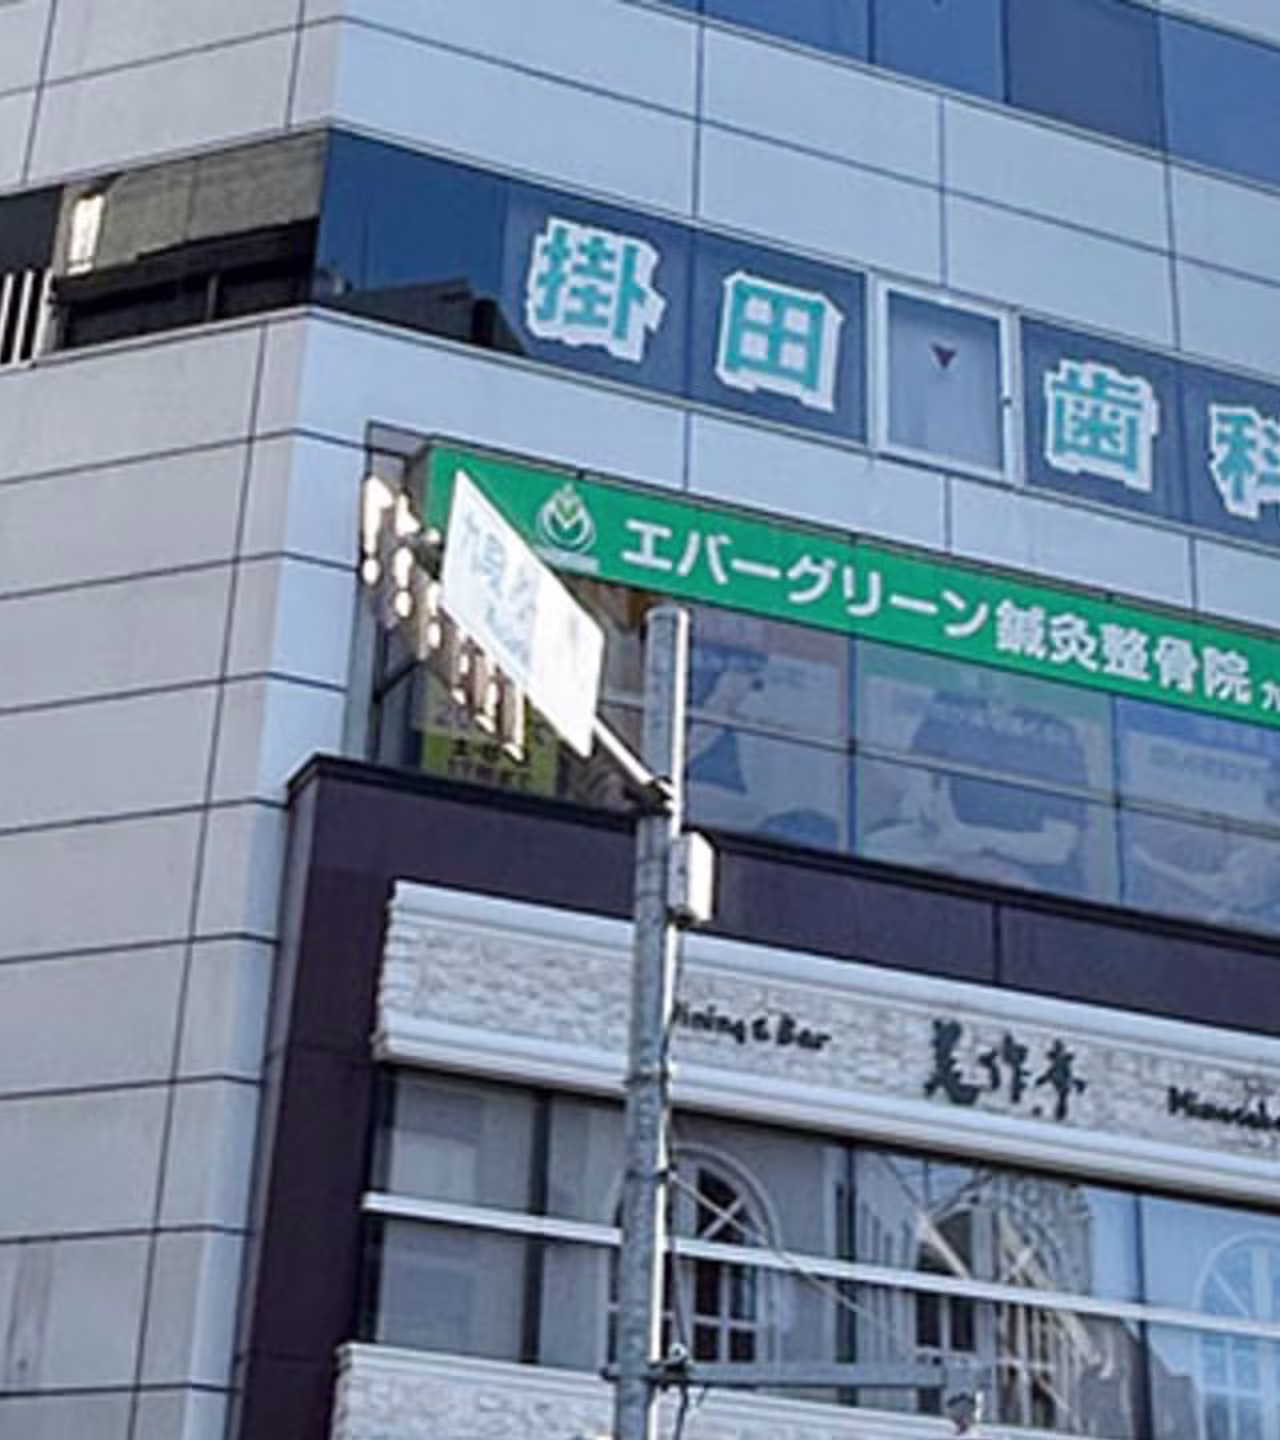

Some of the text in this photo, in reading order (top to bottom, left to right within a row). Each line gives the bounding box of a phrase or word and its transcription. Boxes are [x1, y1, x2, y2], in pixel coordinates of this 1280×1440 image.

[622, 517, 1252, 706] エバーグリーン鍼灸整骨院
[776, 1014, 832, 1051] Bar
